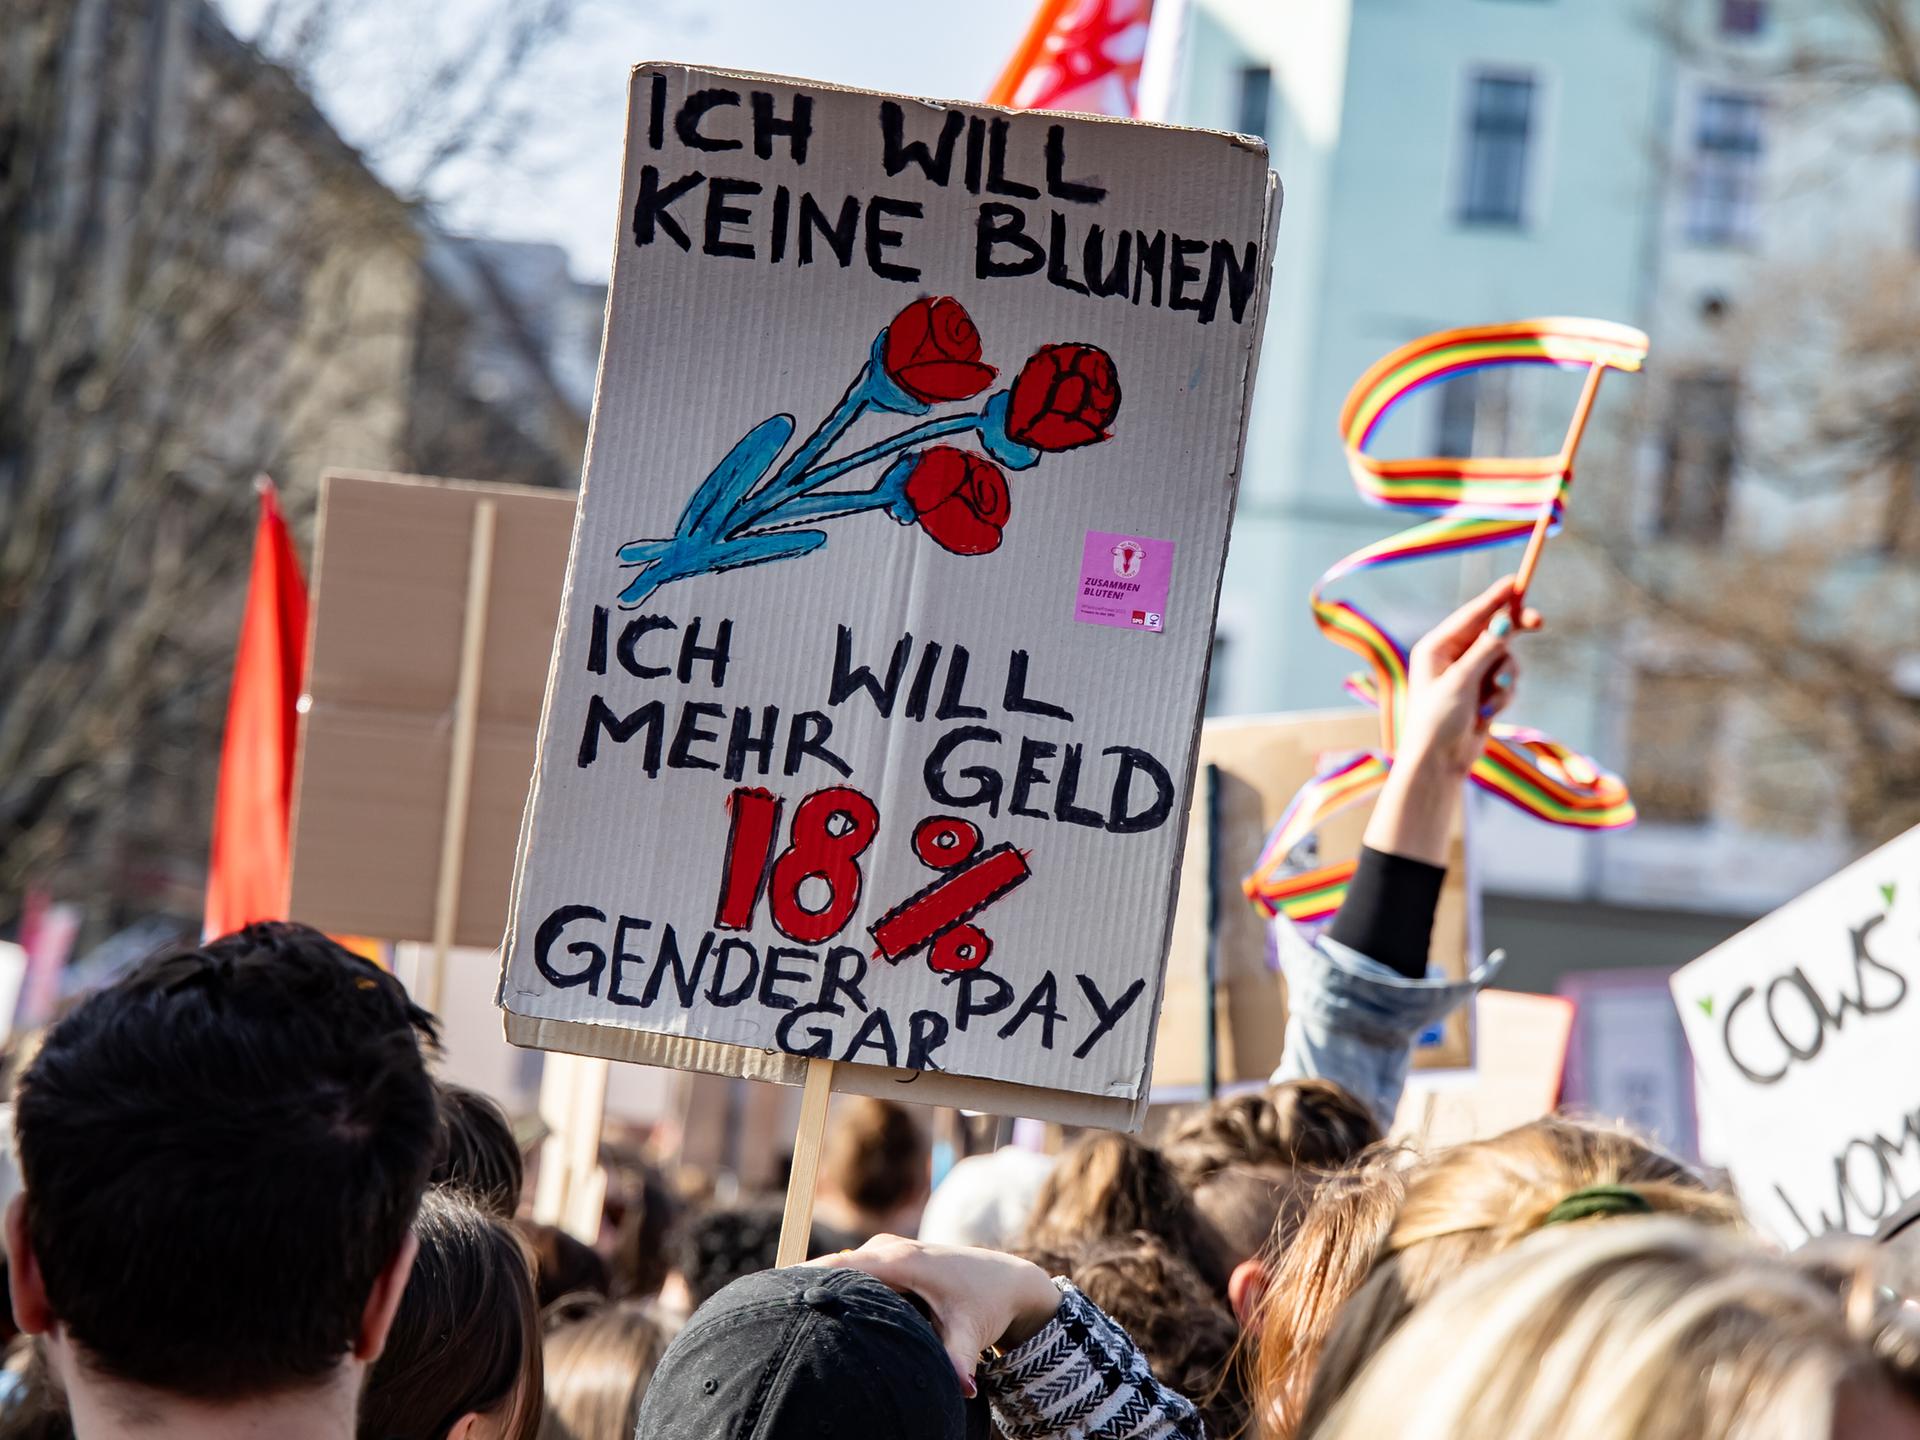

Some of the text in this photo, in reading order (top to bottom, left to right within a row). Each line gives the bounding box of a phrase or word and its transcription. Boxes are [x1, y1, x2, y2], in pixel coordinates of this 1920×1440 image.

[648, 71, 1108, 204] ICH WILL
[633, 164, 1258, 324] KEINE BLUMEN
[1083, 587, 1125, 600] BLUTEN!
[1084, 577, 1141, 592] ZUSAMMEN
[586, 605, 1074, 723] ICH WILL
[577, 695, 1175, 833] MEHR GELD
[534, 904, 1147, 1060] GENDER PAY
